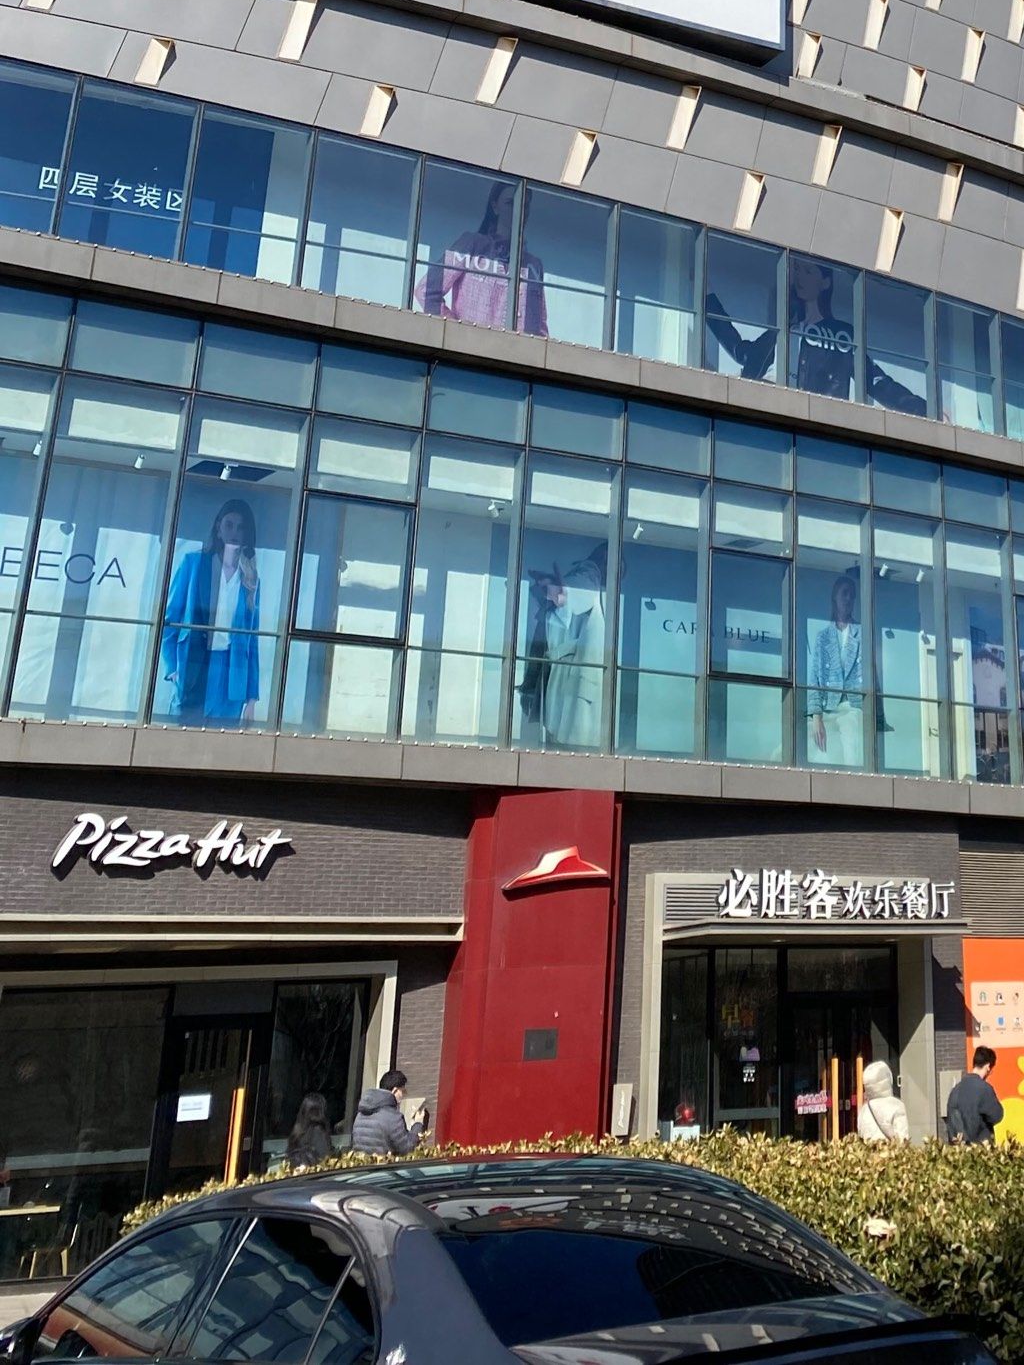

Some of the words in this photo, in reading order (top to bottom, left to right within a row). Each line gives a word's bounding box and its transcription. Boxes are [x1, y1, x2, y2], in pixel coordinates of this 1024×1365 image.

[38, 166, 185, 212] 四层女装区
[53, 813, 191, 868] Pizza
[193, 819, 294, 869] Hut
[718, 867, 956, 920] 必胜客欢乐餐厅
